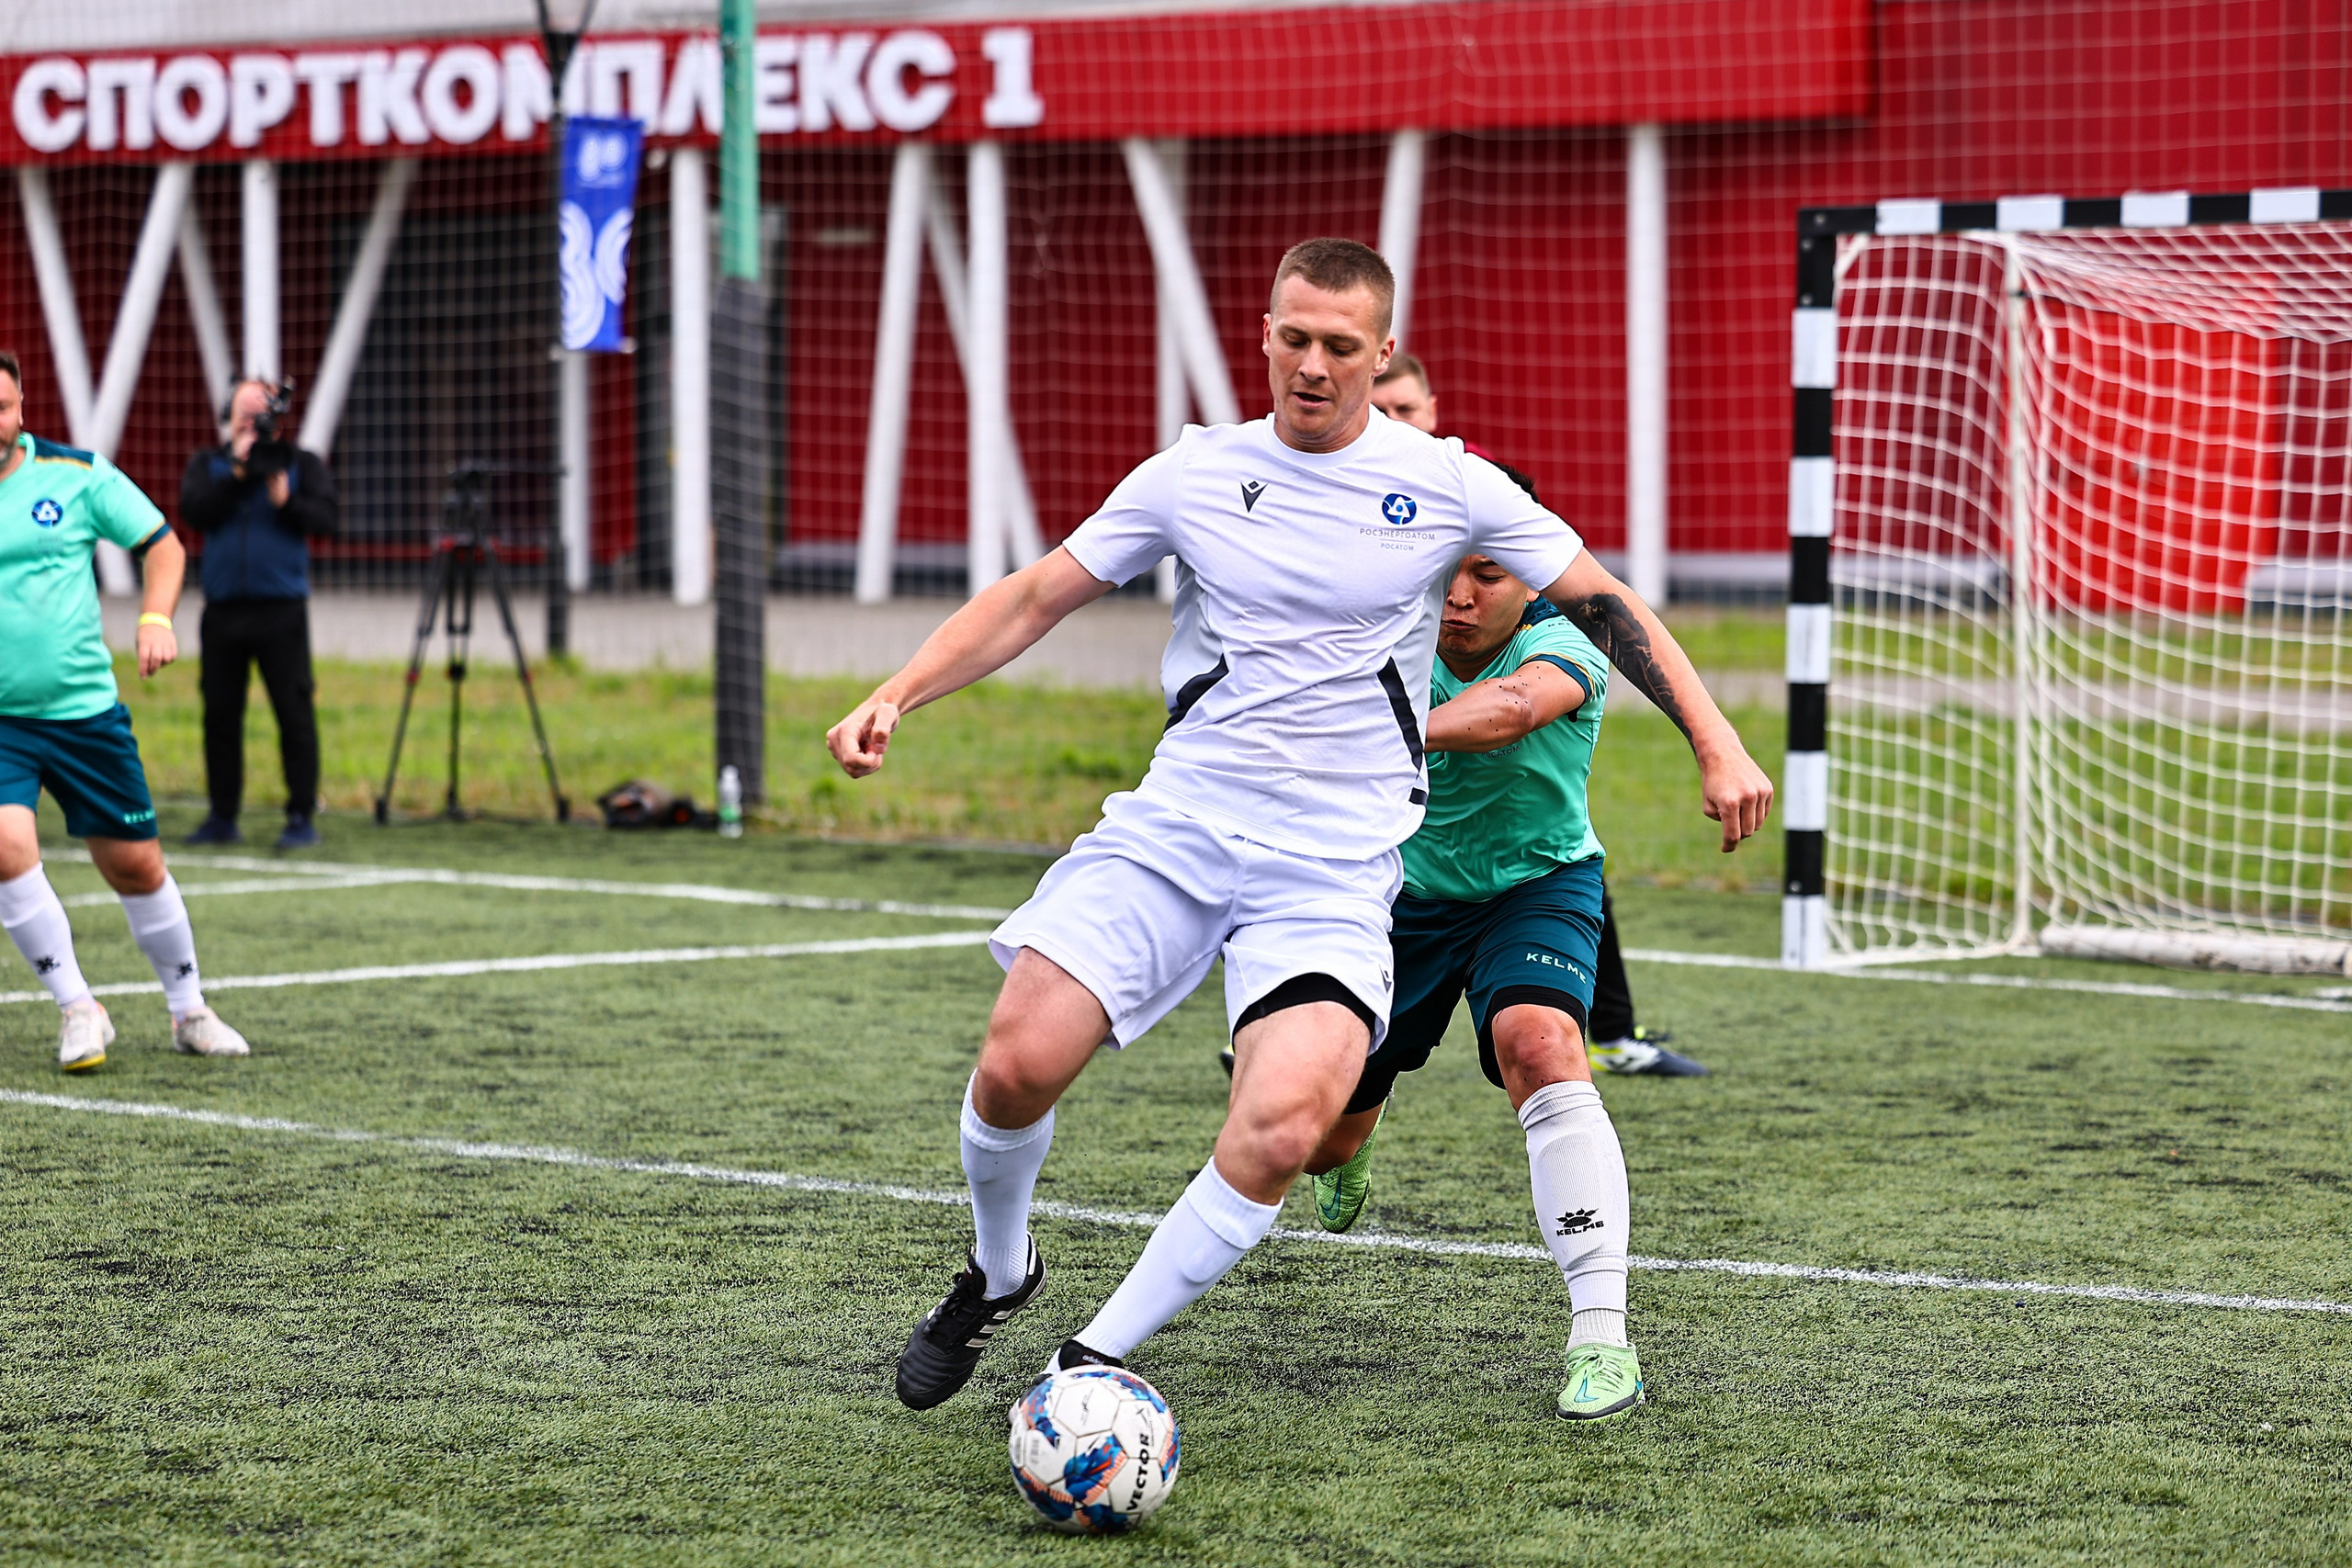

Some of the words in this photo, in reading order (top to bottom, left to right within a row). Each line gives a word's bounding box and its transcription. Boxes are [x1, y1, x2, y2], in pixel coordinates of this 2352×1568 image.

[12, 28, 957, 152] СПОРТКОМПЛЕКС
[982, 27, 1045, 127] 1
[1360, 527, 1435, 540] РОСЭНЕРГОАТОМ
[1380, 543, 1414, 551] РОСАТОМ
[1525, 952, 1587, 985] KELME
[1555, 1220, 1605, 1236] KELME
[1126, 1433, 1148, 1511] VECTOR
